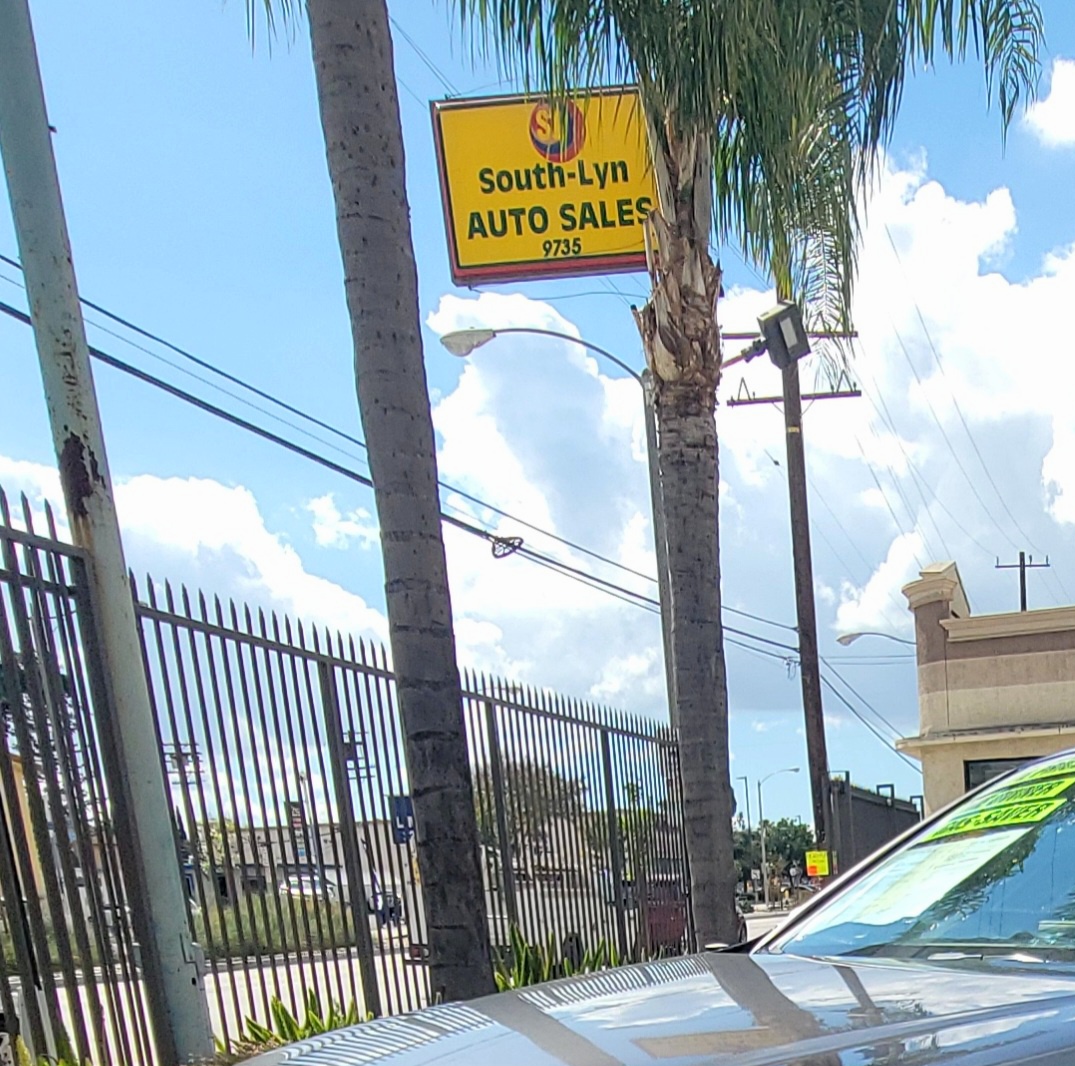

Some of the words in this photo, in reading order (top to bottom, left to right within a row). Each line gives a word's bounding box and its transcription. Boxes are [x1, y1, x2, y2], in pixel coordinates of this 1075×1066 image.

[479, 160, 629, 194] South-Lyn
[467, 205, 549, 240] AUTO
[559, 197, 653, 231] SALES
[542, 238, 582, 257] 9735
